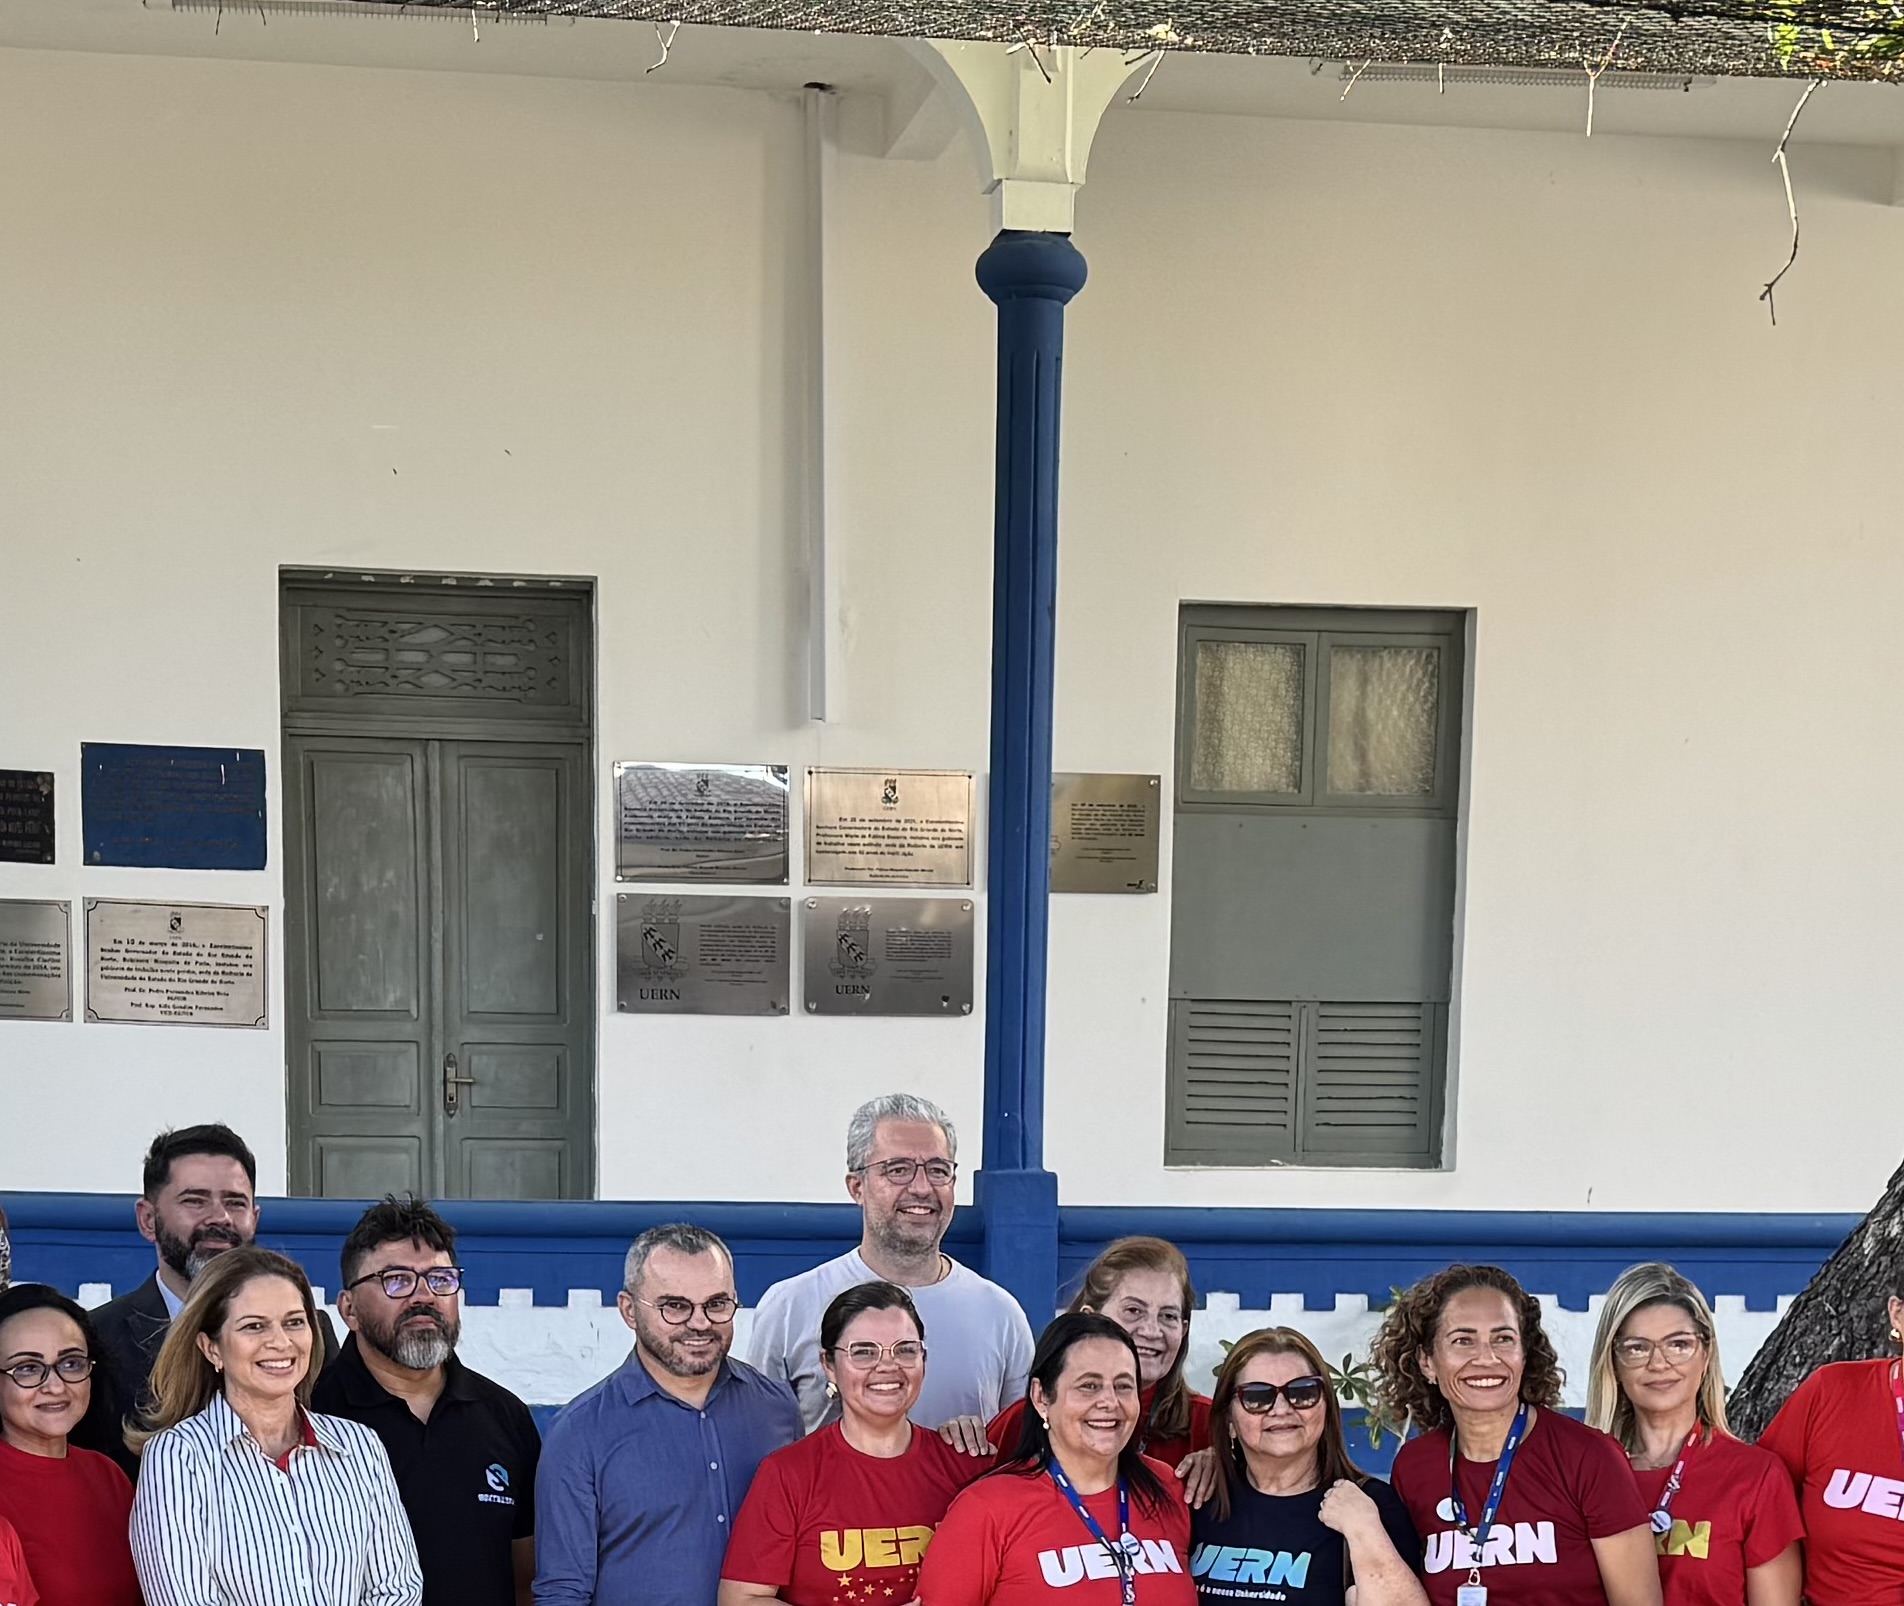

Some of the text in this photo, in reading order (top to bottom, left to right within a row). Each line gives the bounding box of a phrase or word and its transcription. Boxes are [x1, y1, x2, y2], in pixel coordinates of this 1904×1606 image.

[639, 988, 680, 1000] UERN
[835, 985, 870, 995] UERN
[820, 1525, 936, 1571] UER
[1038, 1539, 1183, 1588] UERN
[1191, 1542, 1311, 1588] UERN
[1424, 1521, 1558, 1574] UERN
